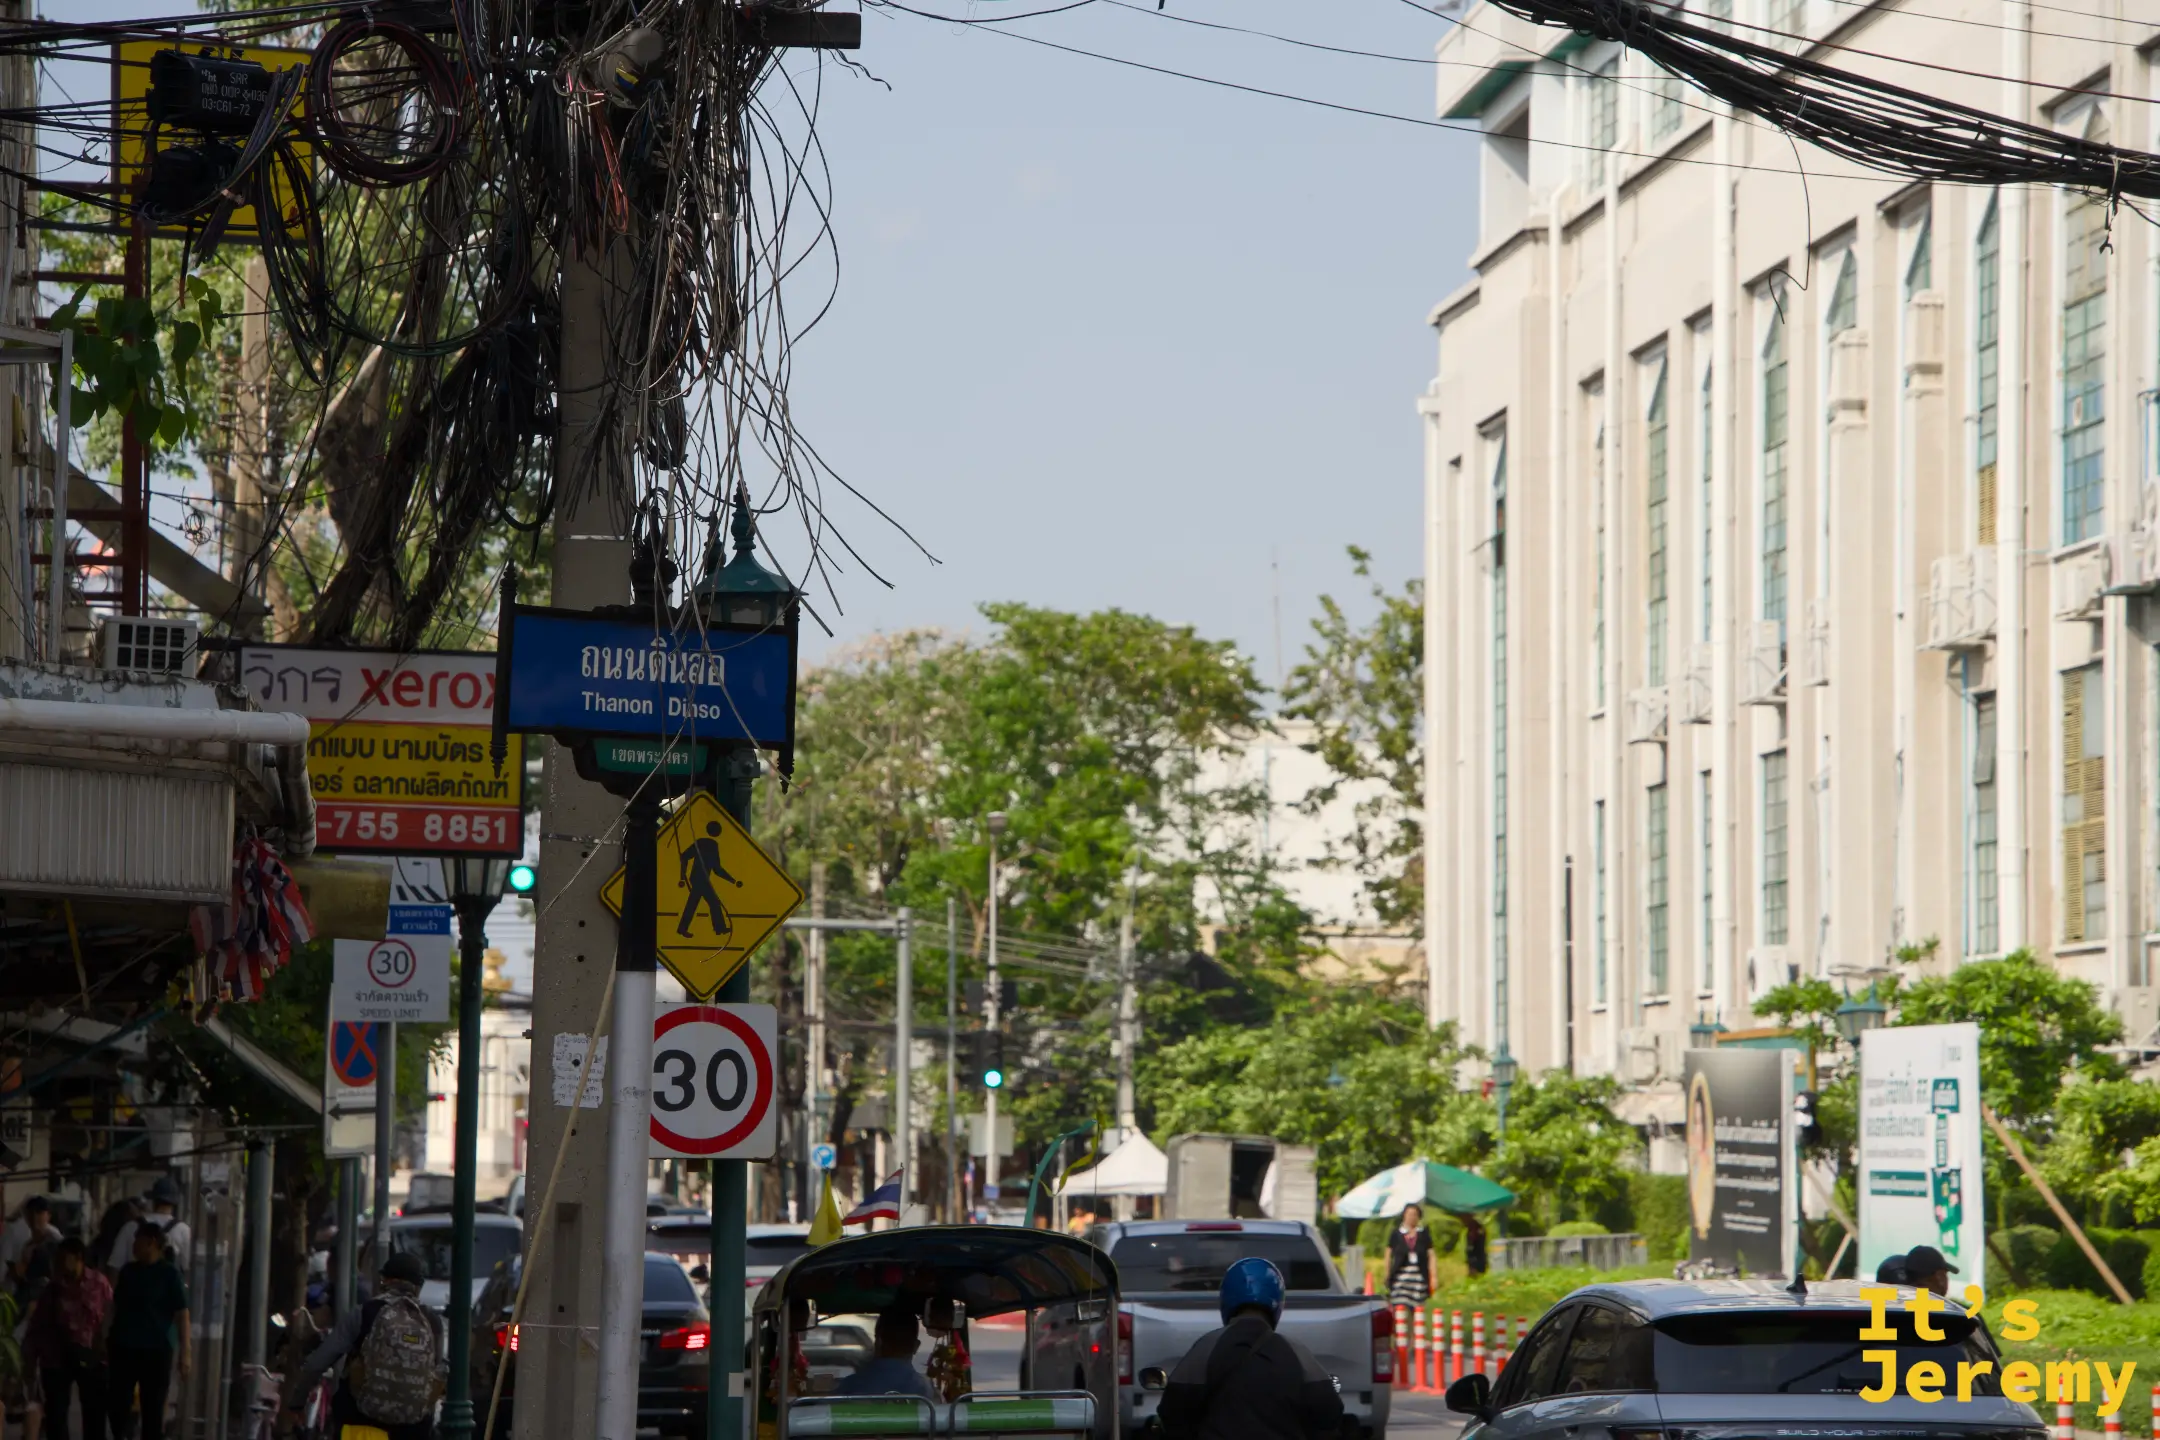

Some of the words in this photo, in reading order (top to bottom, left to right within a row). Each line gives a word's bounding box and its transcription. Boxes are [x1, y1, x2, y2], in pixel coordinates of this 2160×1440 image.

[581, 636, 726, 687] ถนนดินสอ
[581, 690, 653, 715] Thanon
[668, 696, 721, 720] Dinso
[308, 736, 376, 759] กแบบ
[383, 732, 484, 763] นามบัตร
[353, 771, 510, 798] ฉลากผลิตภัณฑ์
[423, 813, 506, 844] 8851
[376, 950, 409, 975] 30
[355, 988, 429, 1003] จำกัดความเร็ว
[360, 1008, 391, 1019] SPEED
[394, 1008, 422, 1019] LIMIT
[653, 1048, 748, 1112] 30
[1776, 1429, 1820, 1437] BUILD
[1823, 1429, 1863, 1437] YOUR
